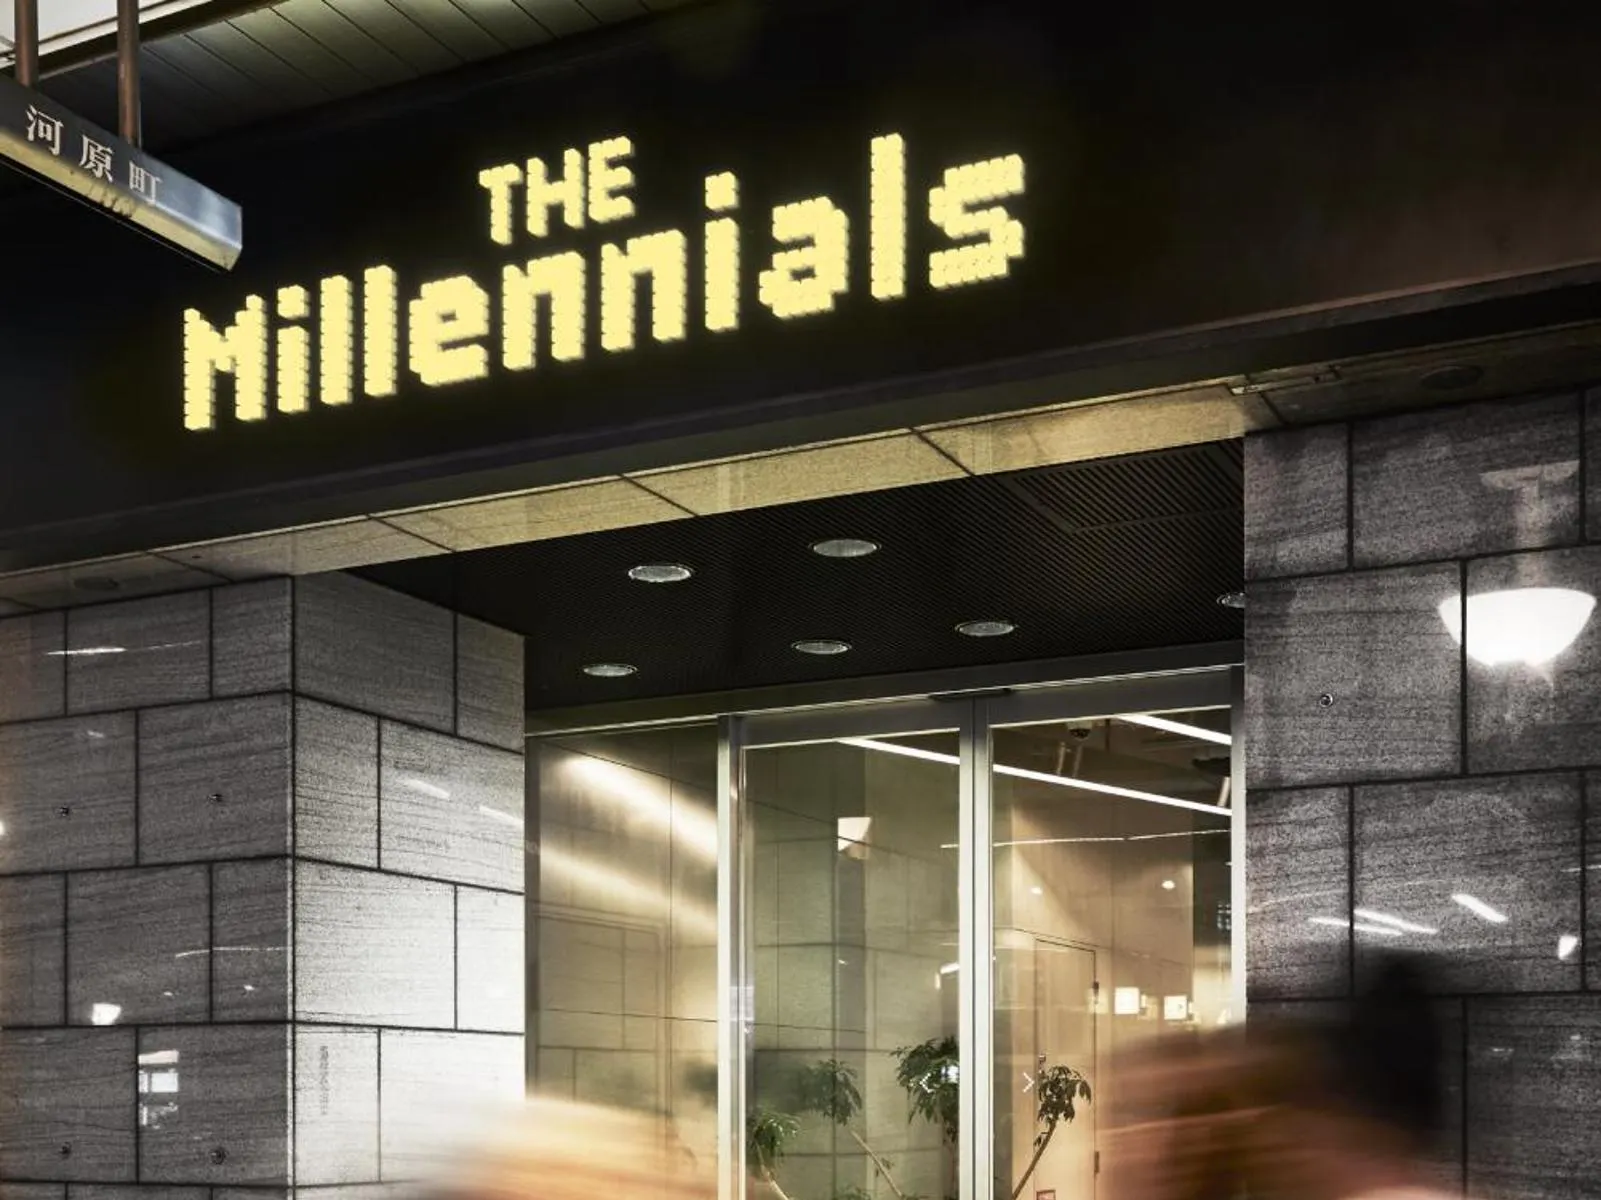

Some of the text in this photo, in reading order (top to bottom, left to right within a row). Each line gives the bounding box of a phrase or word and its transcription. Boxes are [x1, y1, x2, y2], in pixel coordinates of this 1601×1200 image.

[25, 104, 162, 205] 河原町
[479, 135, 635, 244] THE
[184, 133, 1024, 431] Millennials
